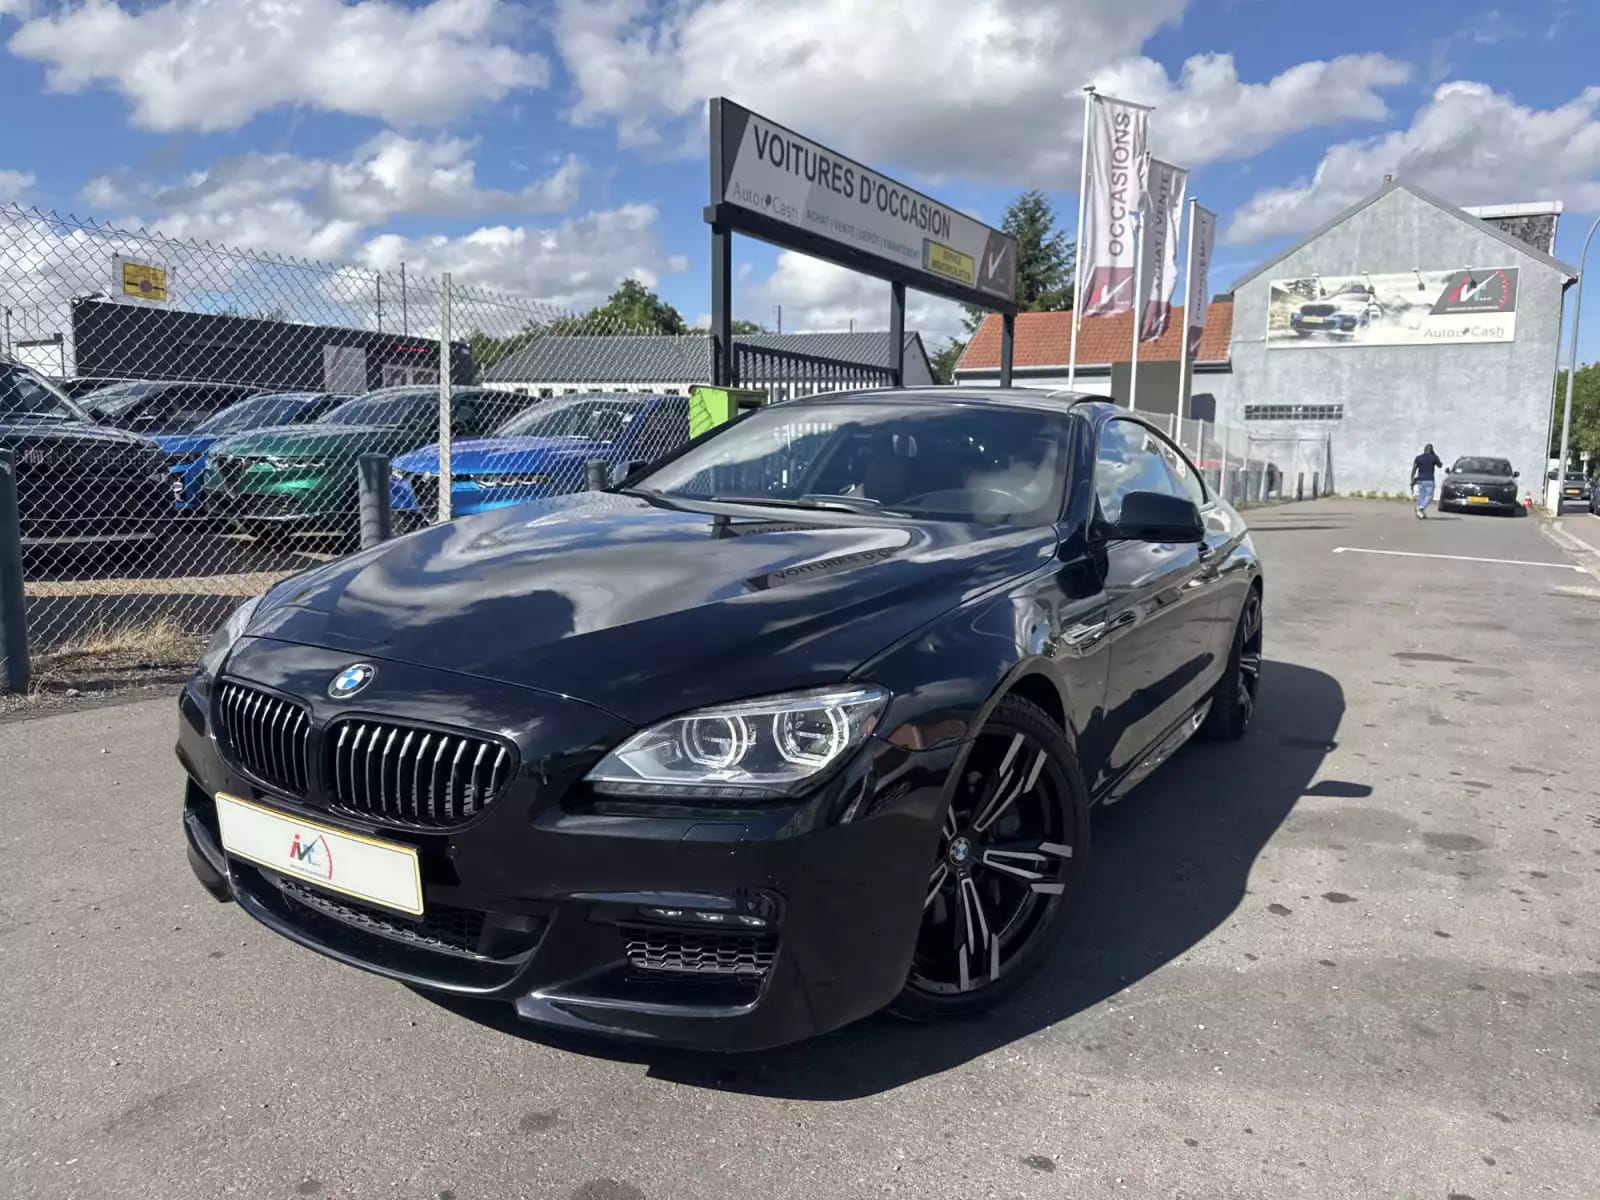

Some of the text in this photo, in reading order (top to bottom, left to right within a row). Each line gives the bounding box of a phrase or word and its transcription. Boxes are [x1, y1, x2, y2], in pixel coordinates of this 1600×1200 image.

[754, 124, 951, 240] VOITURES D'OCCASION
[1108, 112, 1131, 257] OCCASIONS
[1156, 172, 1171, 225] VENTE
[1471, 325, 1505, 337] Cash
